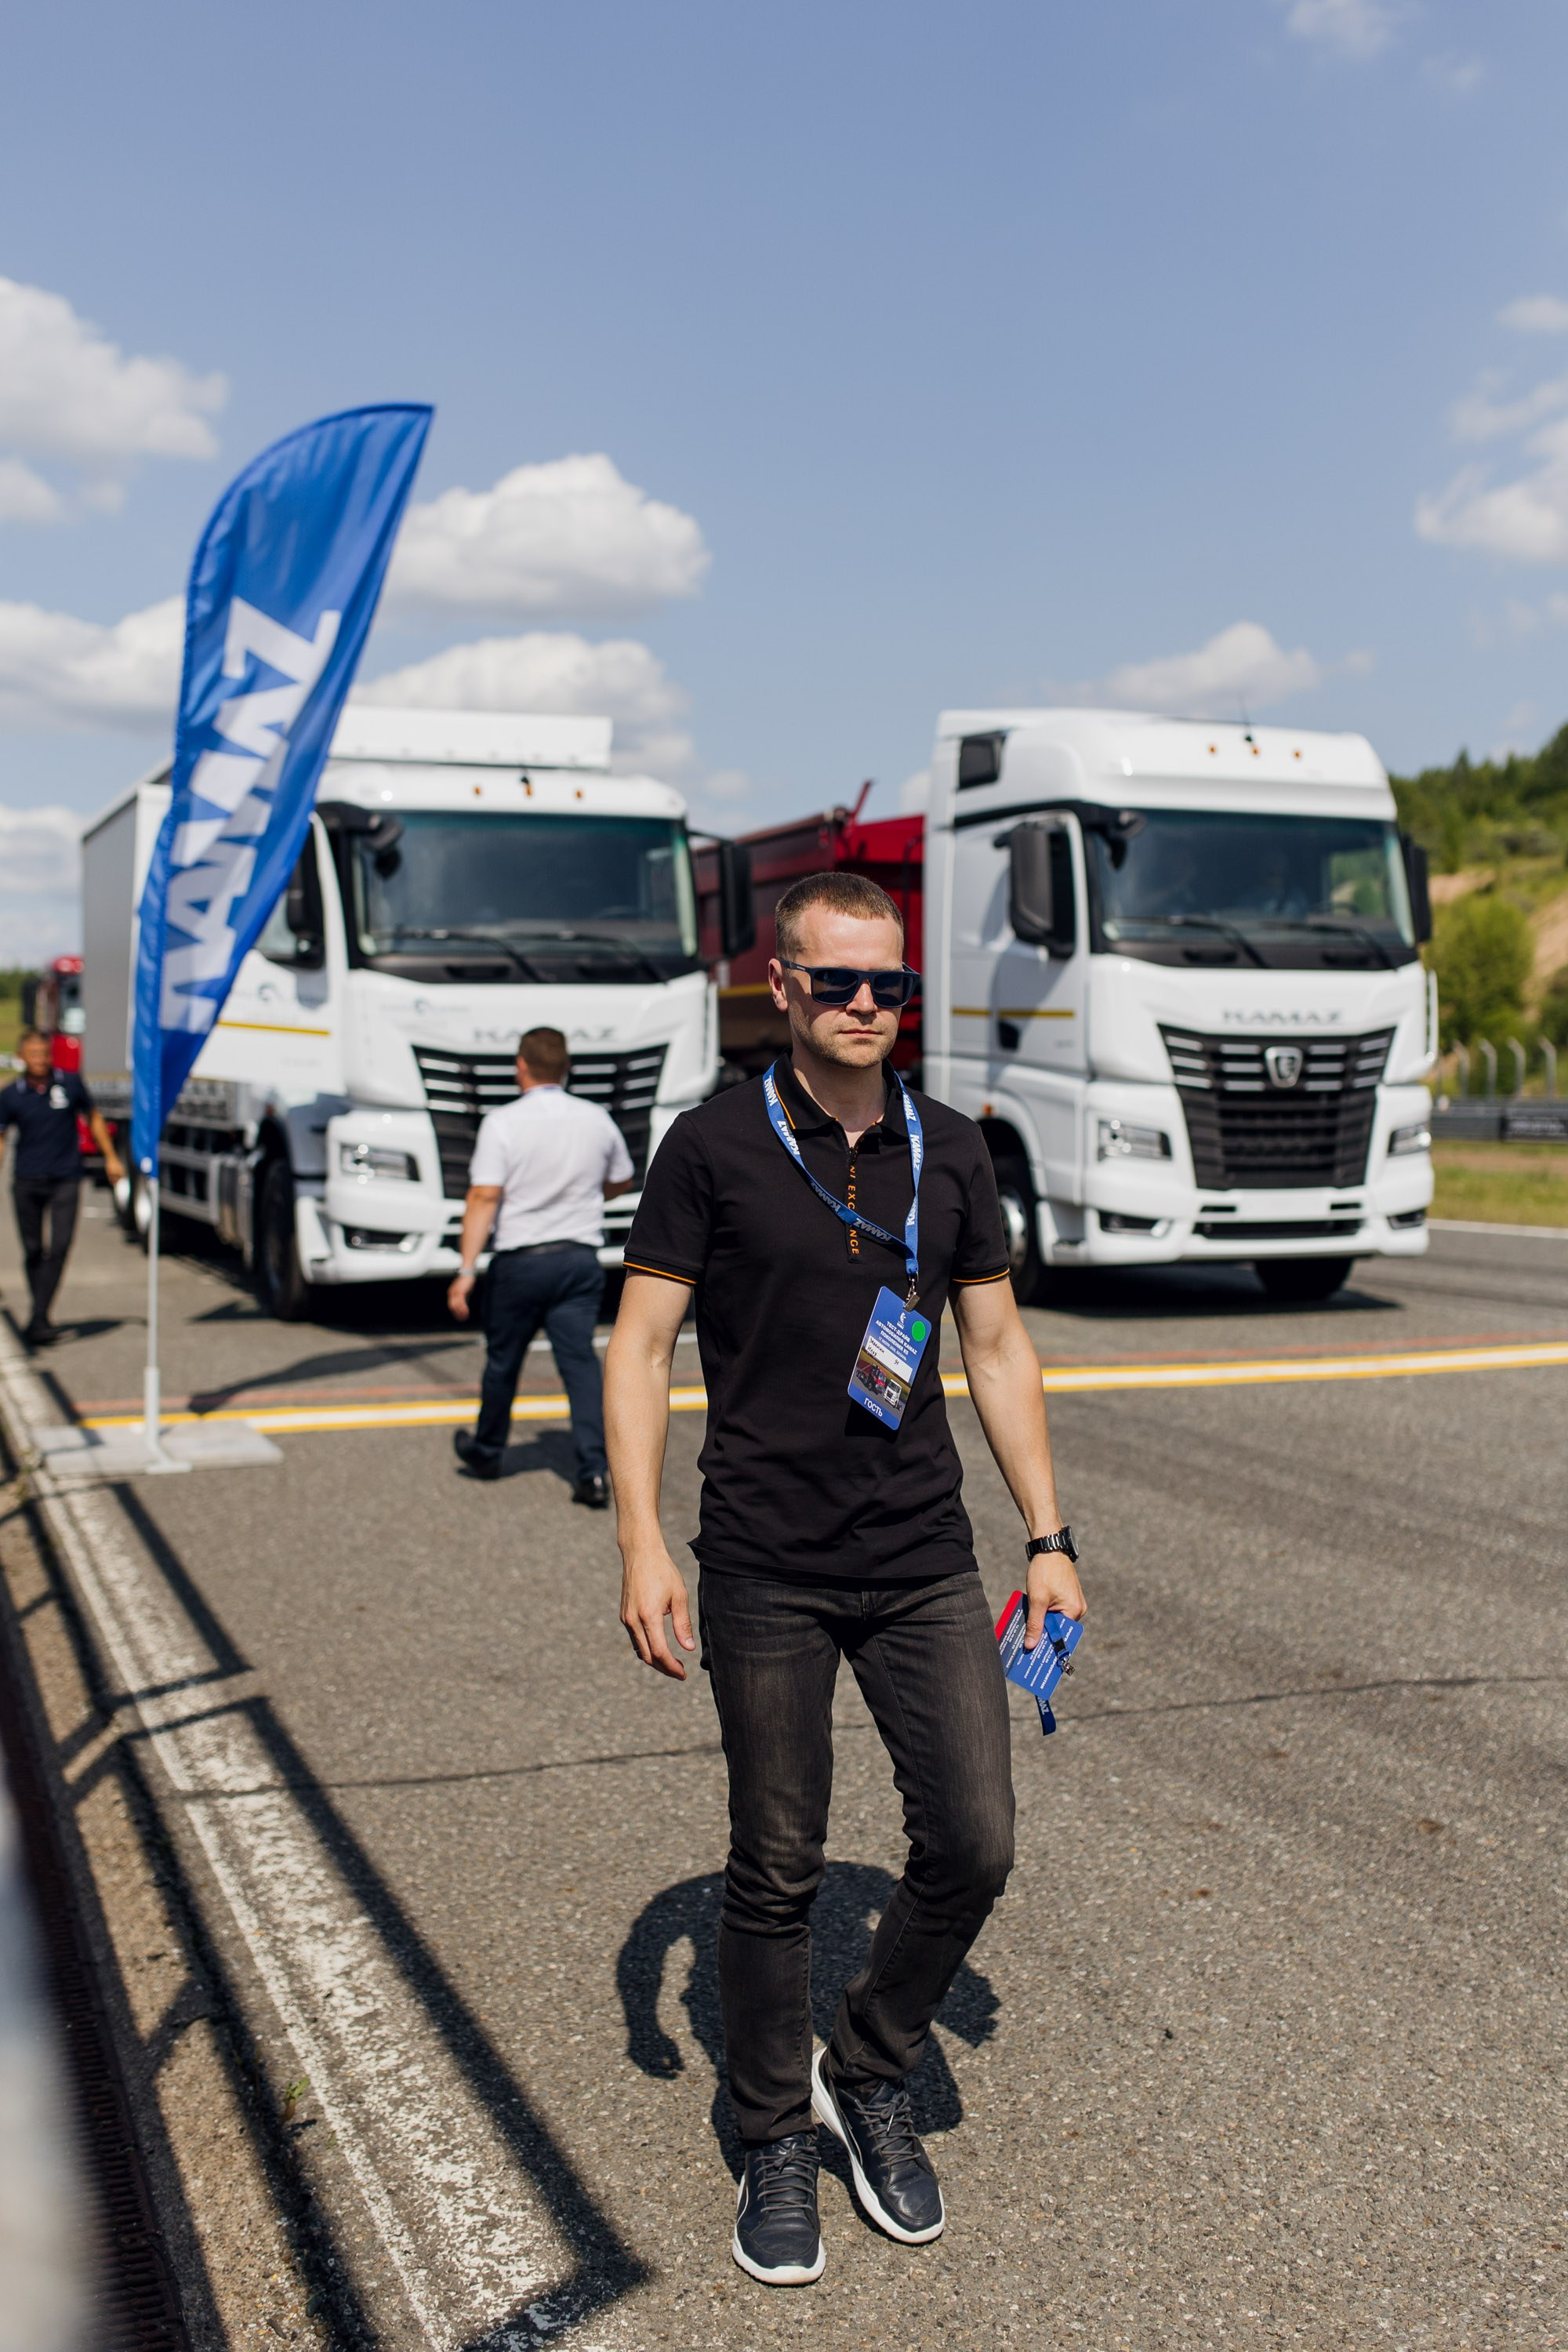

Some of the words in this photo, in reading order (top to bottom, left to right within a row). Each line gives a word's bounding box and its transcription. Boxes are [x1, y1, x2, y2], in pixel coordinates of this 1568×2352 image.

[159, 596, 342, 1034] KAMAZ
[1222, 1008, 1342, 1025] KAMAZ
[474, 1025, 617, 1043] KAAZ
[764, 1075, 779, 1107] KAMAZ
[777, 1120, 800, 1156] KAMAZ
[909, 1134, 921, 1171] KAMAZ
[848, 1185, 859, 1254] EXCNGE
[853, 1218, 891, 1242] KAMAZ
[885, 1320, 910, 1342] ТЕСТ-ДРАЙВ
[863, 1397, 884, 1417] ГОСТЬ
[1063, 1625, 1073, 1642] ПРОГР
[1037, 1697, 1050, 1715] MAZ
